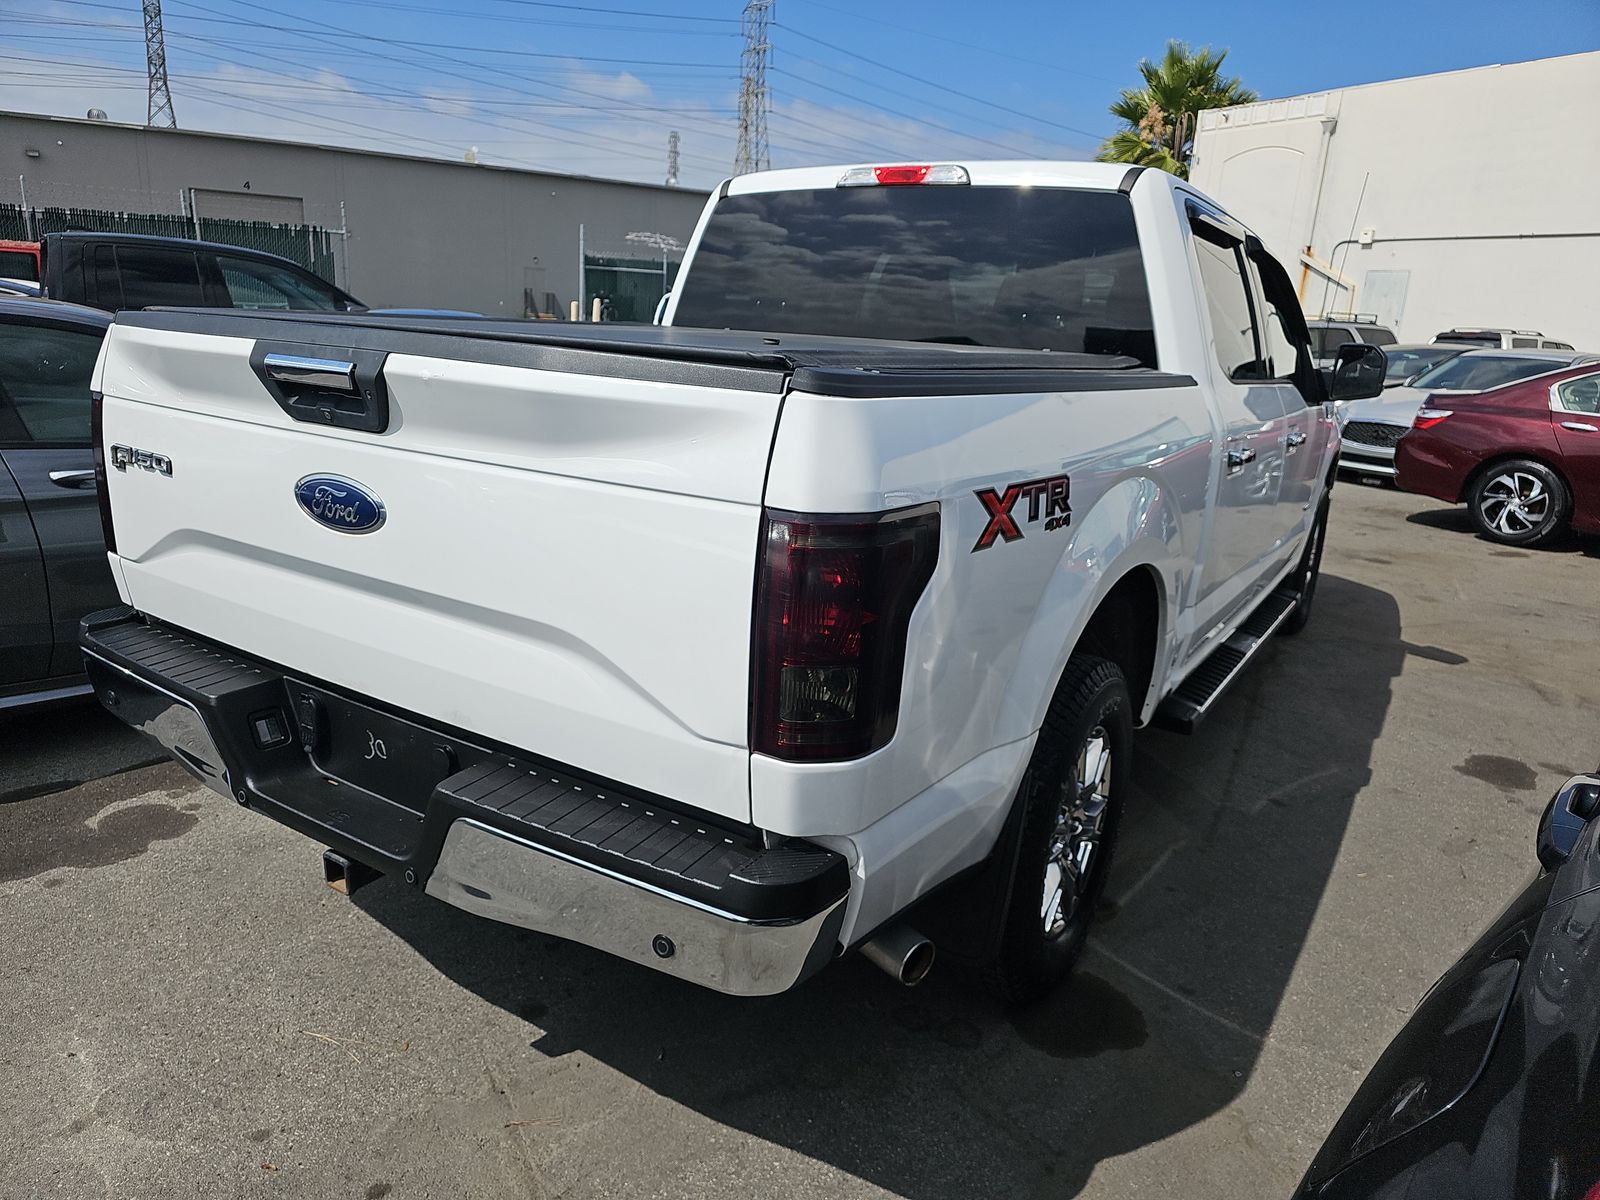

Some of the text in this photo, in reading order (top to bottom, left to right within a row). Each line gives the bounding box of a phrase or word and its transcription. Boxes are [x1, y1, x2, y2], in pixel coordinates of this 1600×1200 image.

[243, 181, 251, 190] 4
[311, 485, 360, 523] Ford
[970, 474, 1072, 554] XTR
[364, 729, 387, 759] 30
